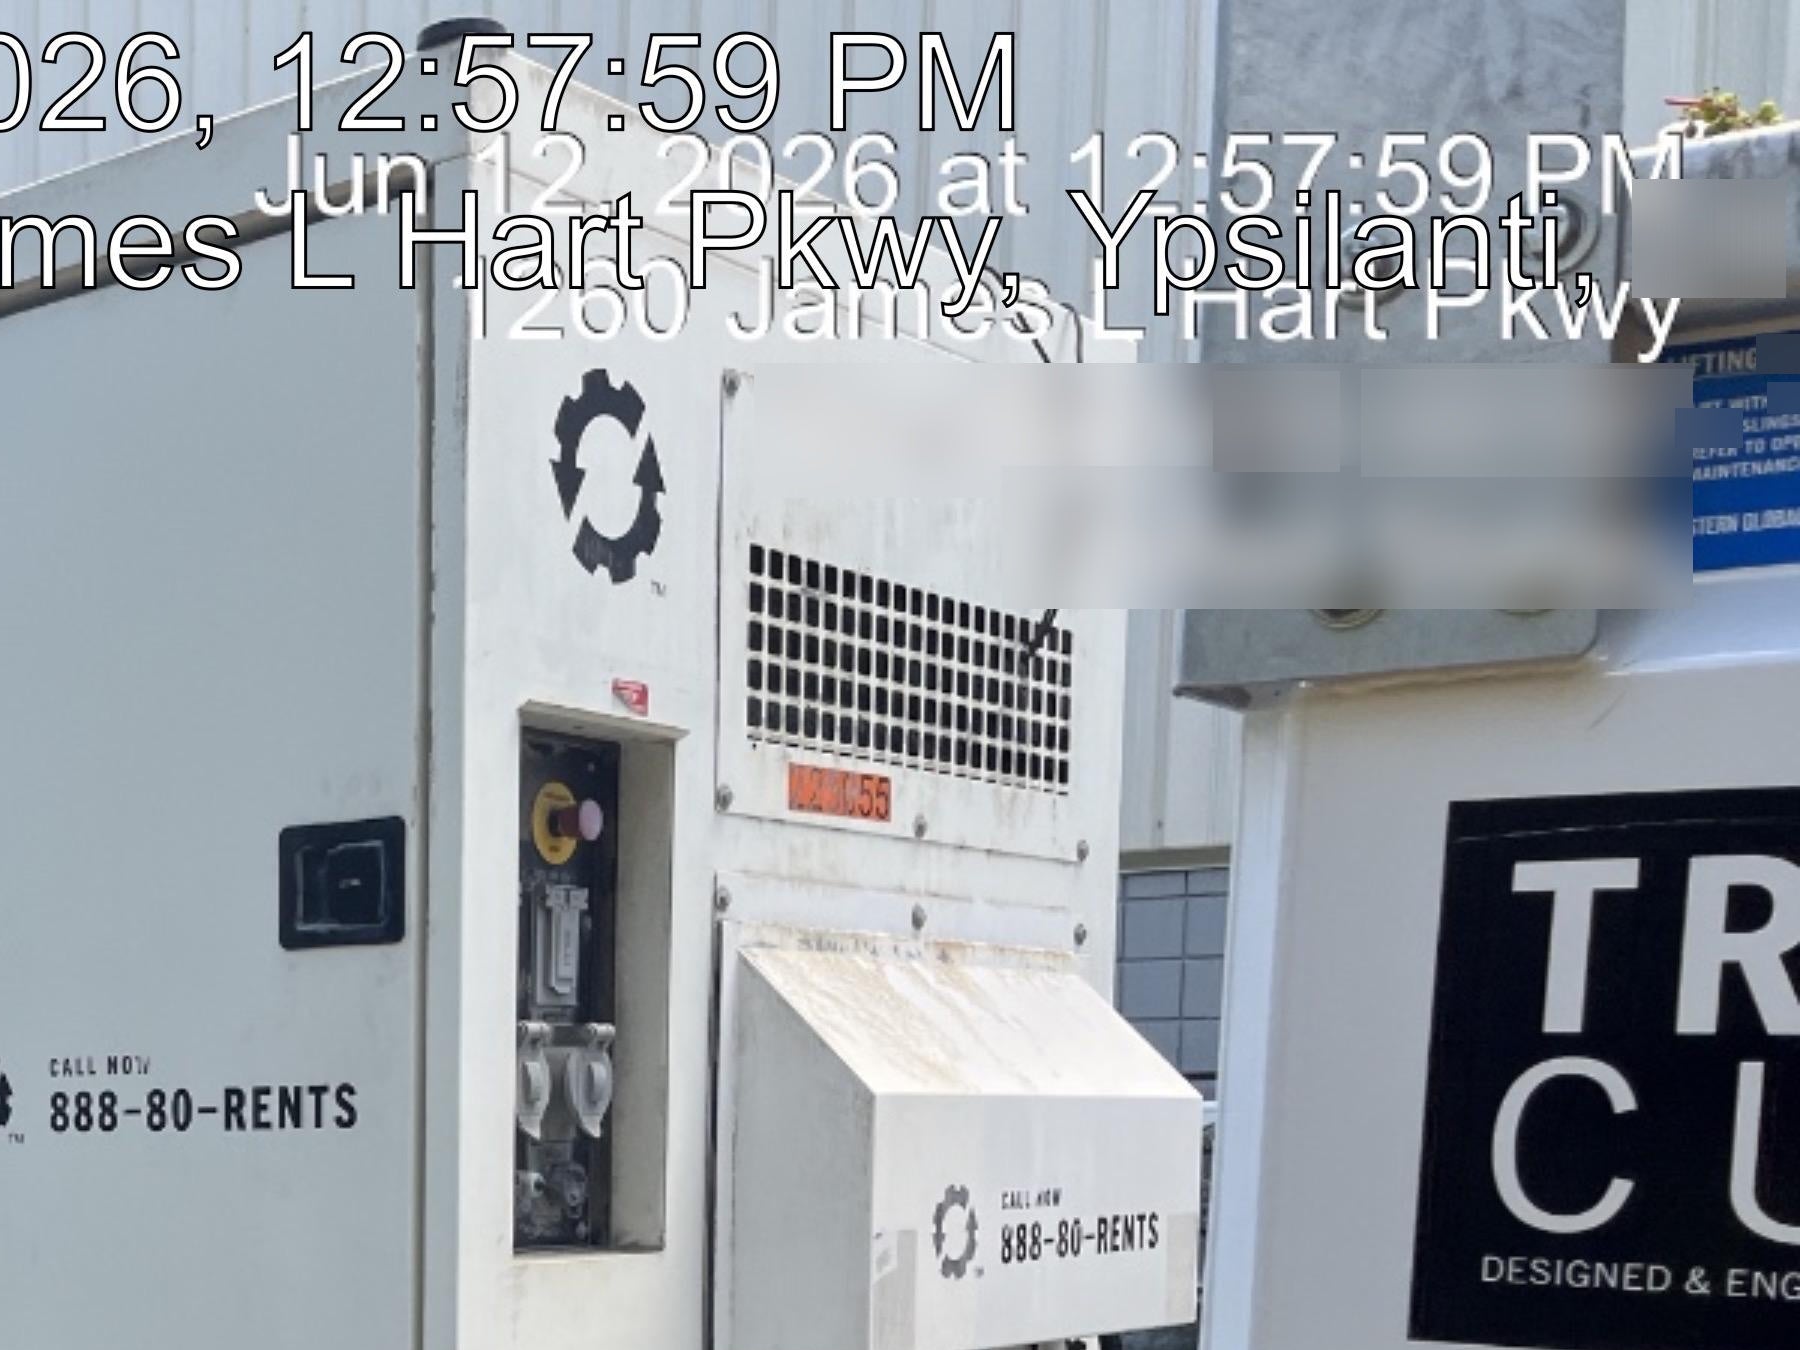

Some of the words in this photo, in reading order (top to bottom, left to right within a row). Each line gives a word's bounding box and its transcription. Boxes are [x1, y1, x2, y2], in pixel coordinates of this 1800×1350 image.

[50, 1058, 97, 1077] CALL
[50, 1083, 358, 1132] 888-80-RENTS
[1001, 1211, 1160, 1265] 888-80-RENTS
[1480, 1254, 1673, 1293] DESIGNED
[1684, 1264, 1712, 1295] &
